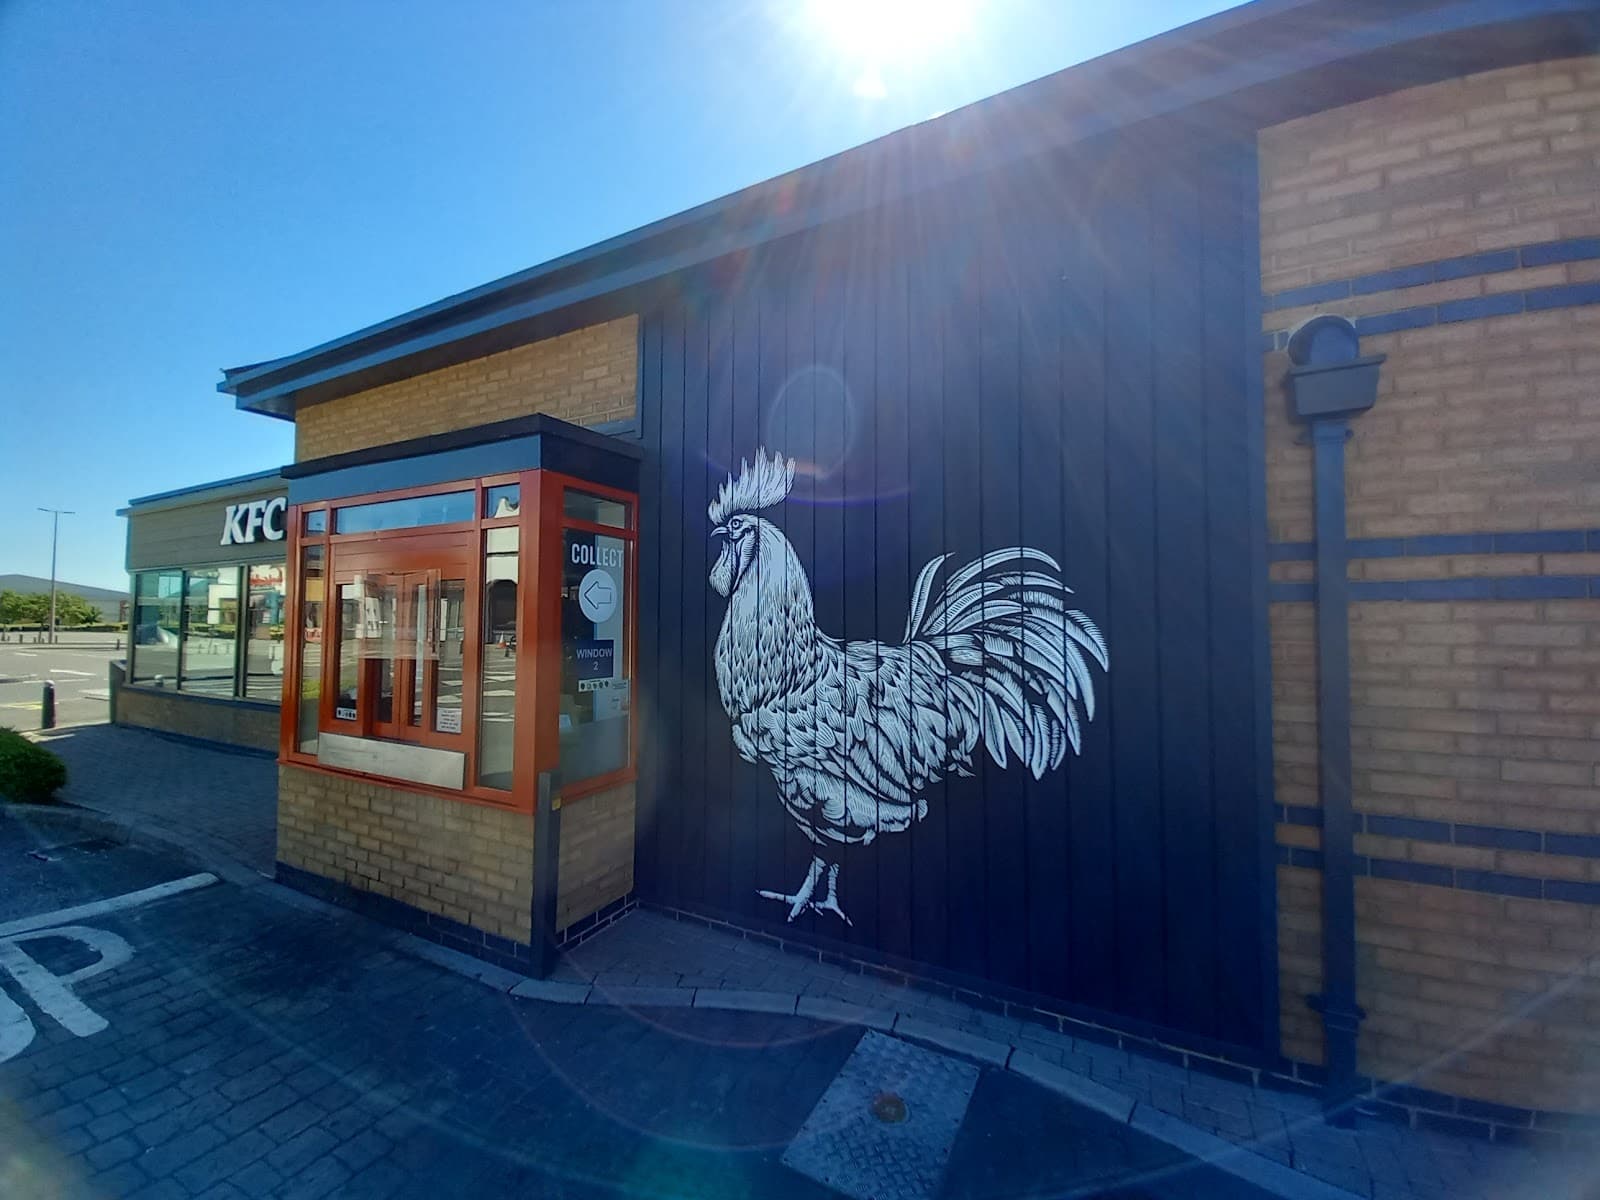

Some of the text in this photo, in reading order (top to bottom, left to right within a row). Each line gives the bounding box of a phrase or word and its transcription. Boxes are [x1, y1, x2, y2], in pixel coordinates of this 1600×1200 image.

[220, 497, 287, 546] KFC
[571, 543, 624, 568] COLLECT
[576, 648, 613, 659] WINDOW
[593, 661, 599, 671] 2
